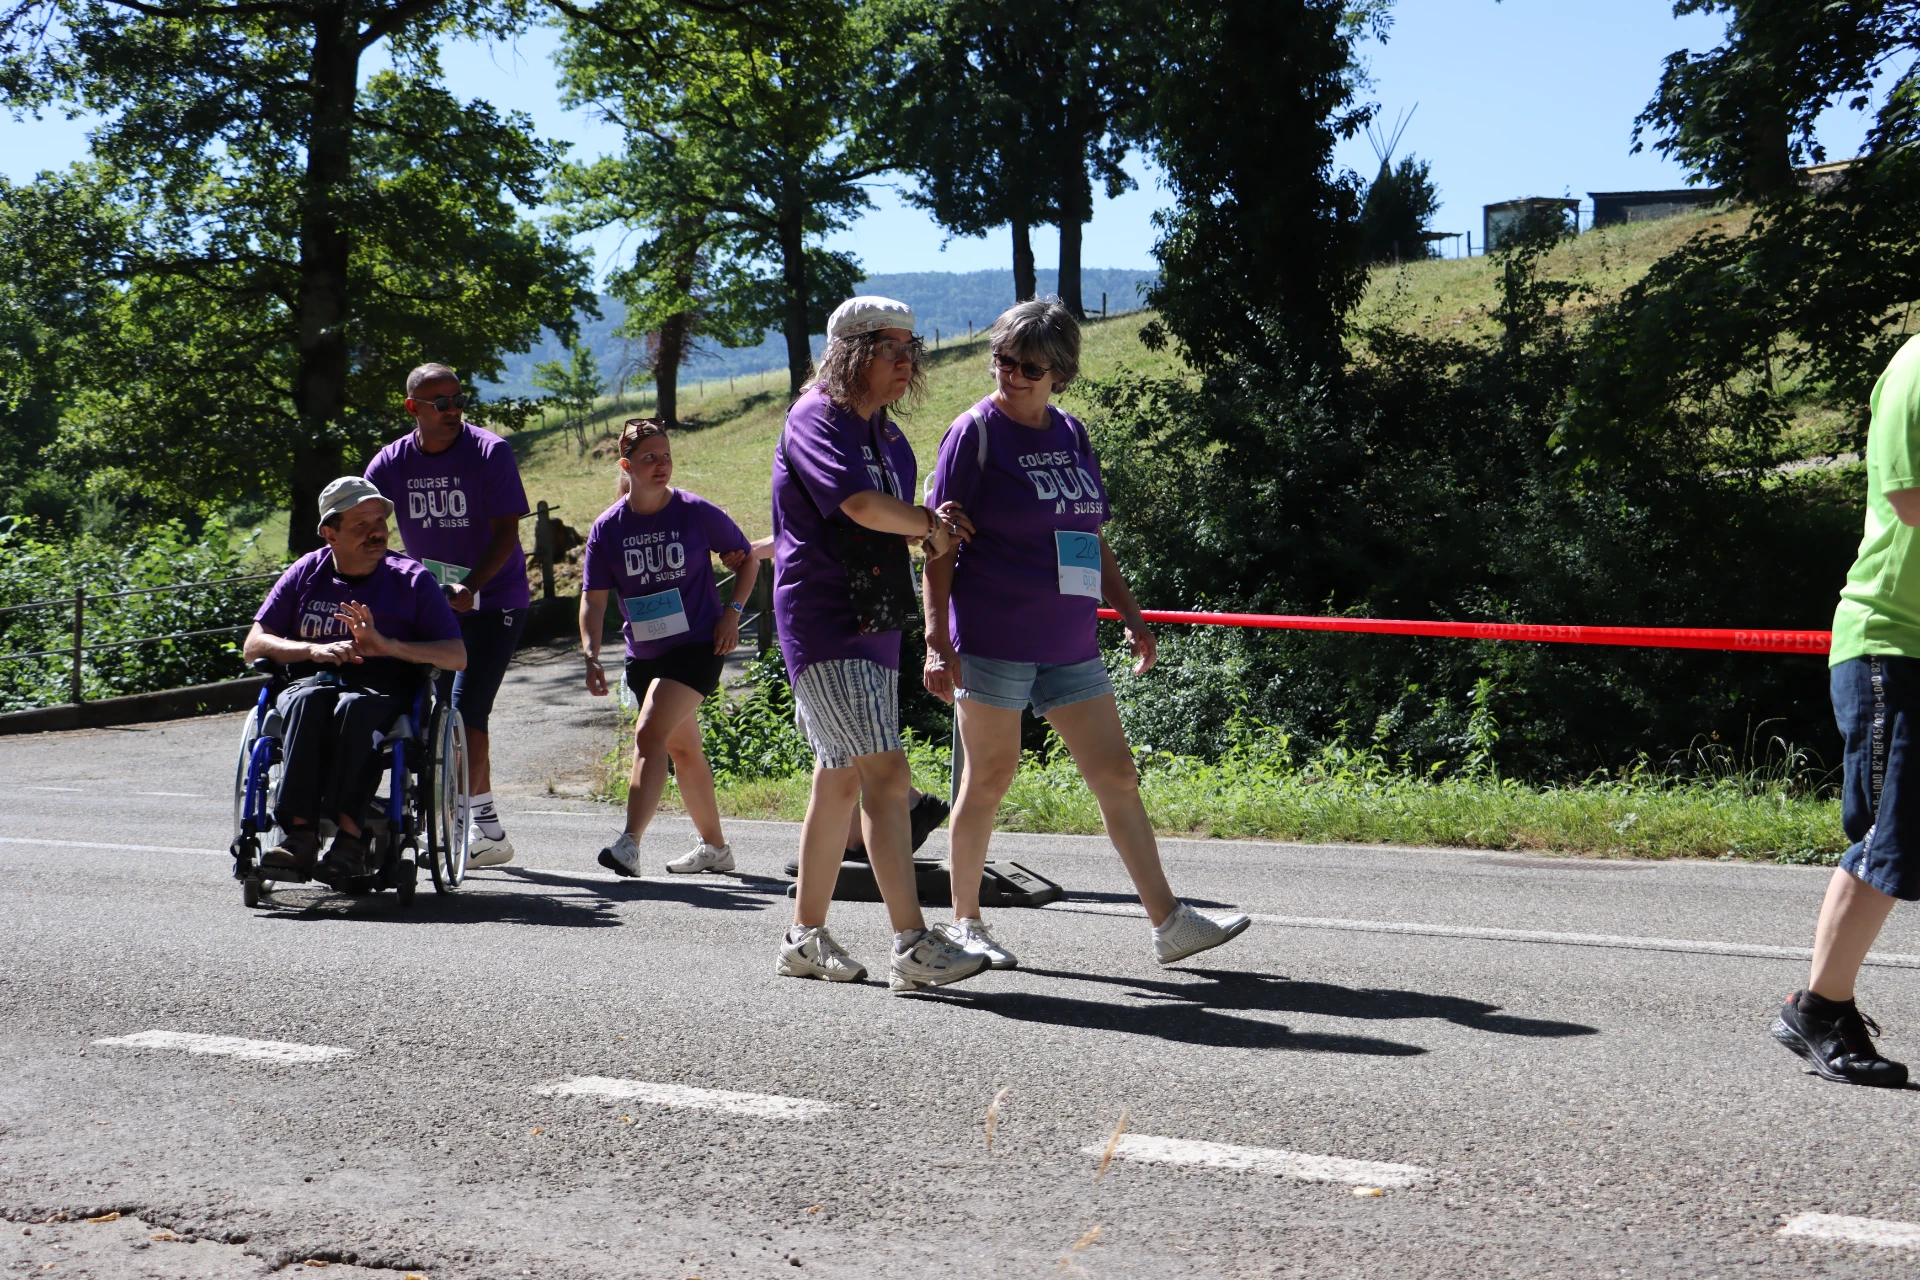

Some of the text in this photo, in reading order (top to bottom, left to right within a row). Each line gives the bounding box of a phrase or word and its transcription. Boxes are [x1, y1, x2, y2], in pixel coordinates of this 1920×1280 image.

[1018, 451, 1071, 467] COURSE
[407, 477, 448, 488] COURSE
[1026, 467, 1099, 500] DUO
[409, 490, 467, 518] DUO
[439, 518, 469, 528] SUISSE
[623, 531, 665, 547] COURSE
[1074, 536, 1098, 559] 20
[624, 542, 685, 576] DUO
[655, 569, 687, 582] SUISSE
[636, 597, 673, 615] 204
[1474, 624, 1581, 639] RAIFFEISEN
[1734, 631, 1831, 650] RAIFFEIS
